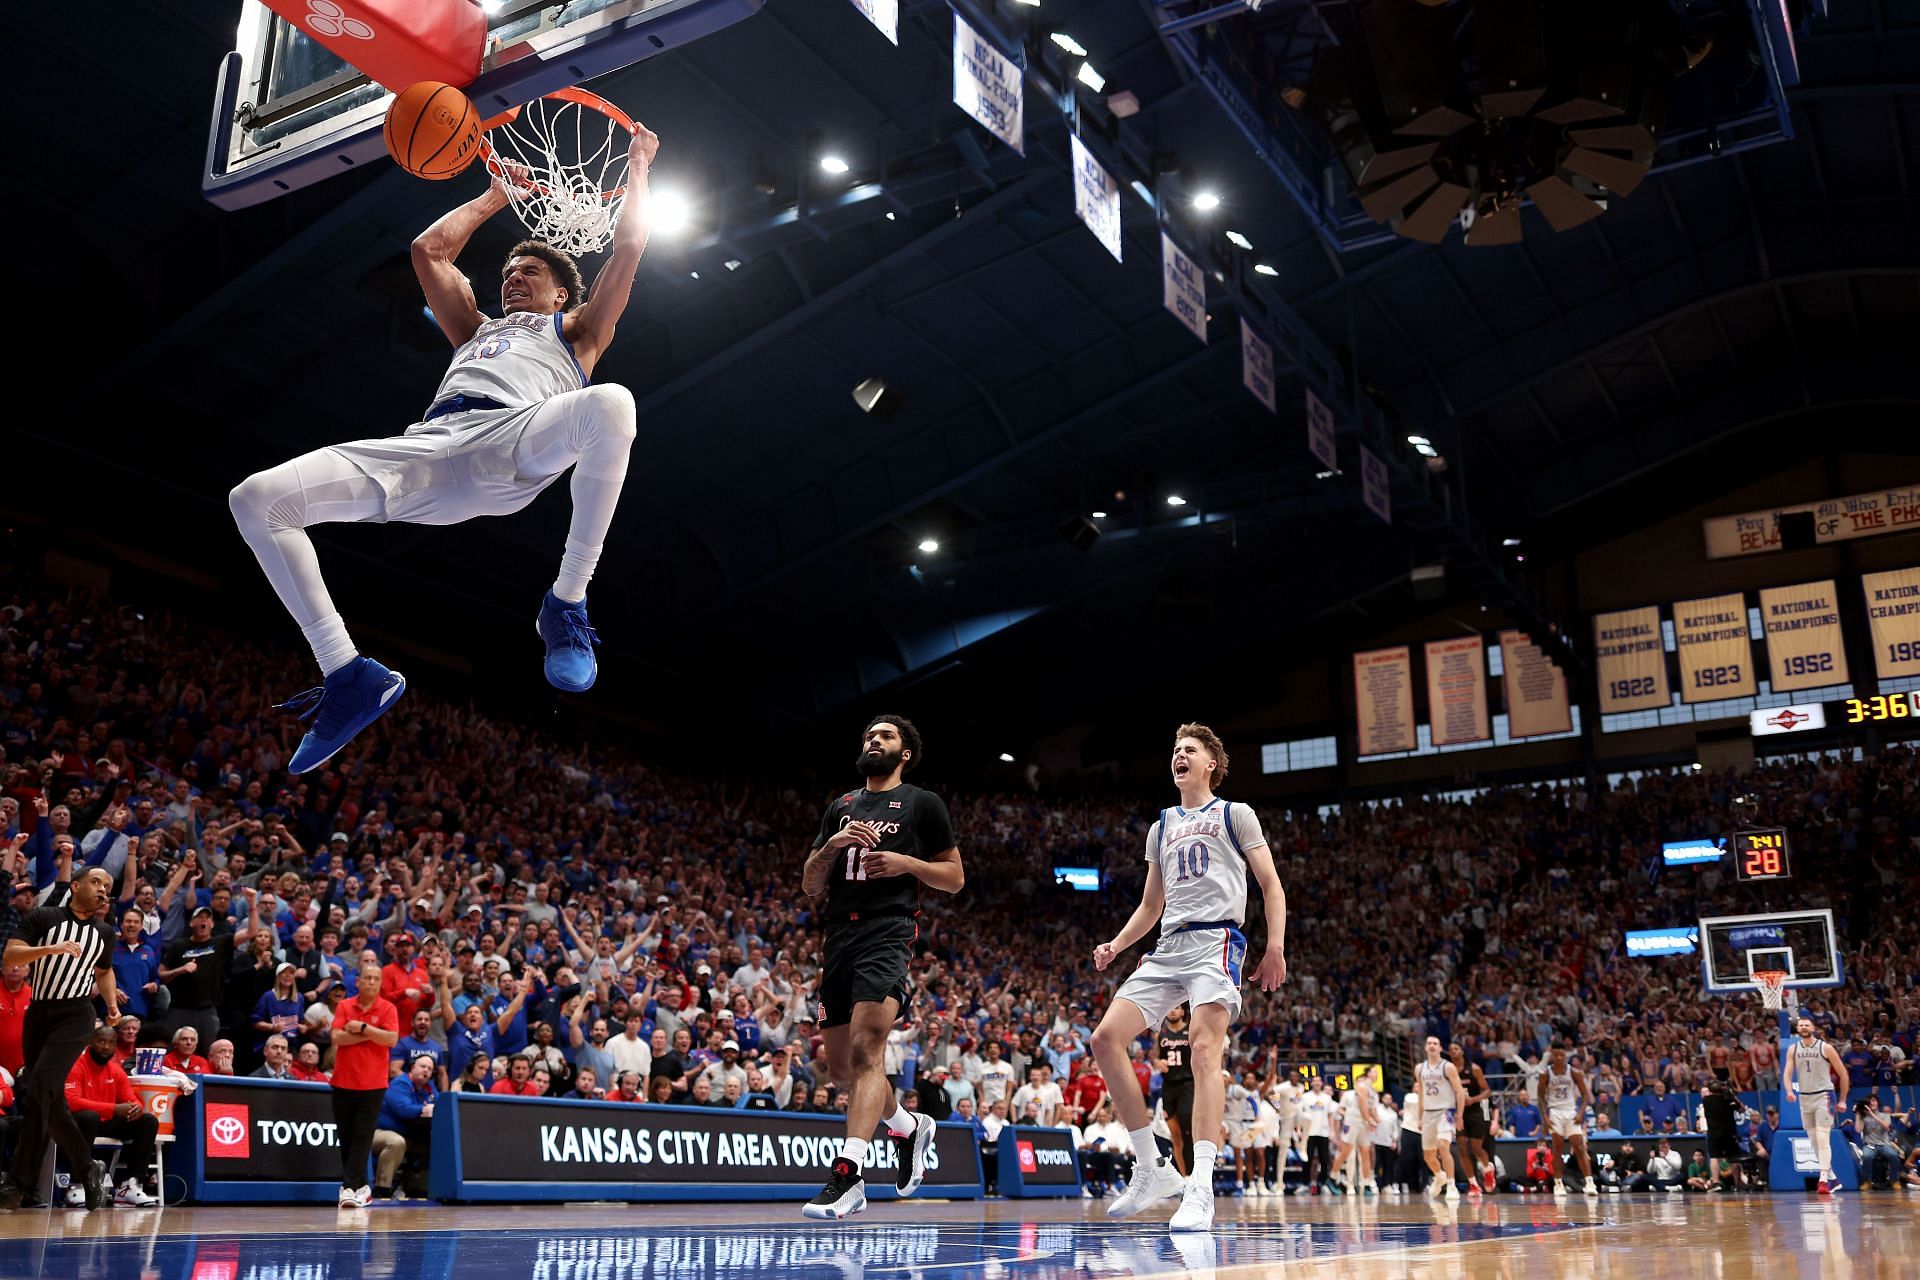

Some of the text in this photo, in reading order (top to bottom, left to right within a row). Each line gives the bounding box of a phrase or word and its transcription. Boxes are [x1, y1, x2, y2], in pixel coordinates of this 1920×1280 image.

[1816, 519, 1840, 536] OF
[1771, 598, 1830, 616] NATIONAL
[1870, 600, 1920, 619] CHAMPI
[1683, 611, 1739, 629] NATIONAL
[1766, 613, 1838, 633] CHAMPIONS
[1601, 624, 1653, 641] NATIONAL
[1678, 626, 1747, 646] CHAMPIONS
[1597, 639, 1660, 657] CHAMPIONS
[1888, 640, 1920, 663] 198
[1783, 652, 1834, 677] 1952
[1694, 664, 1742, 689] 1923
[1610, 676, 1657, 700] 1922
[1845, 693, 1908, 723] 3:36
[1166, 821, 1221, 848] KANSAS
[1747, 834, 1783, 849] 7:41
[1176, 841, 1210, 882] 10
[1745, 848, 1781, 876] 28
[1167, 1050, 1183, 1067] 21
[151, 1095, 168, 1114] G
[257, 1120, 340, 1147] TOYOT
[540, 1125, 939, 1170] KANSAS CITY AREA TOYOT DEAS
[1034, 1149, 1073, 1166] TOYOTA
